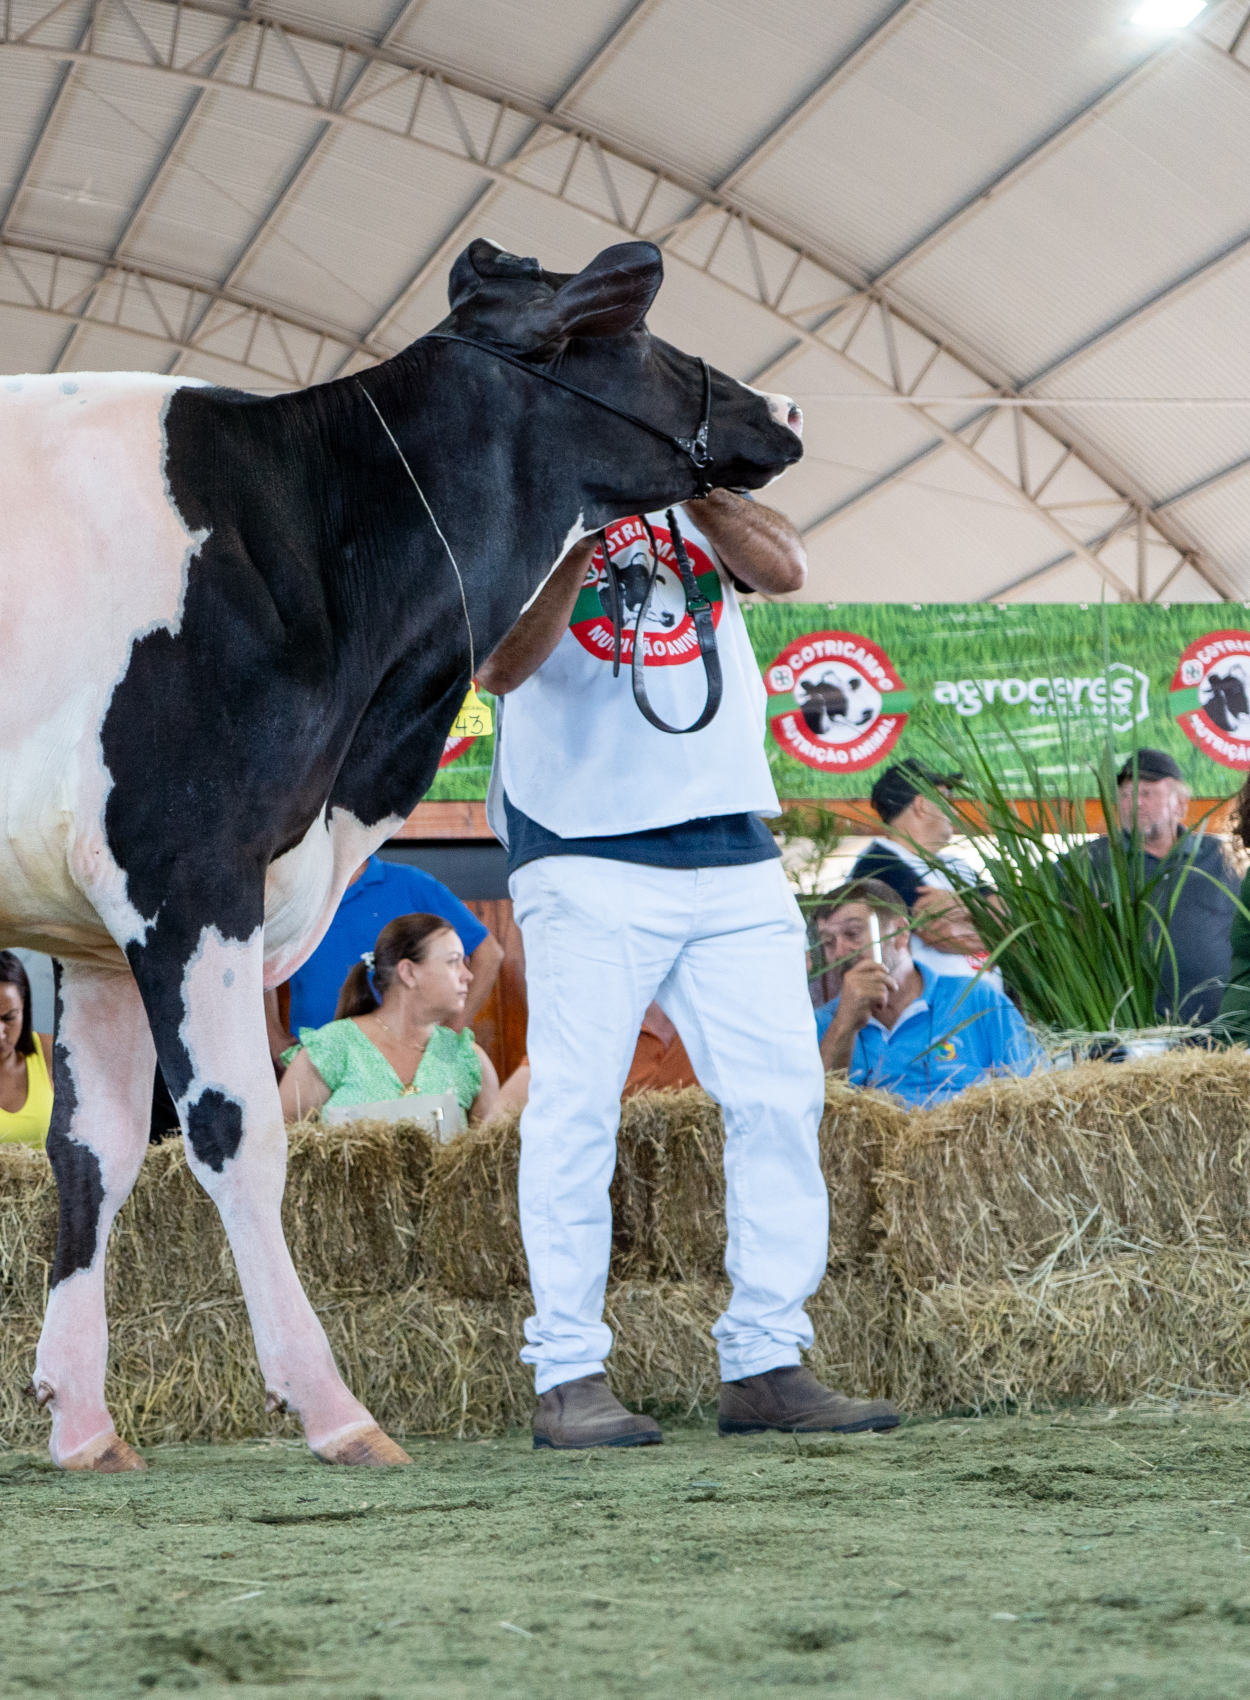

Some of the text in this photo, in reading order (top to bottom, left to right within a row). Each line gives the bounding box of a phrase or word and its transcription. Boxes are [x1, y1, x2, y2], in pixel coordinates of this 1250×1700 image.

[788, 639, 895, 691] COTRICAMPO
[934, 677, 1134, 717] agroceres
[455, 714, 484, 736] 43
[780, 715, 897, 764] NUTRIÇÃO ANIMAL
